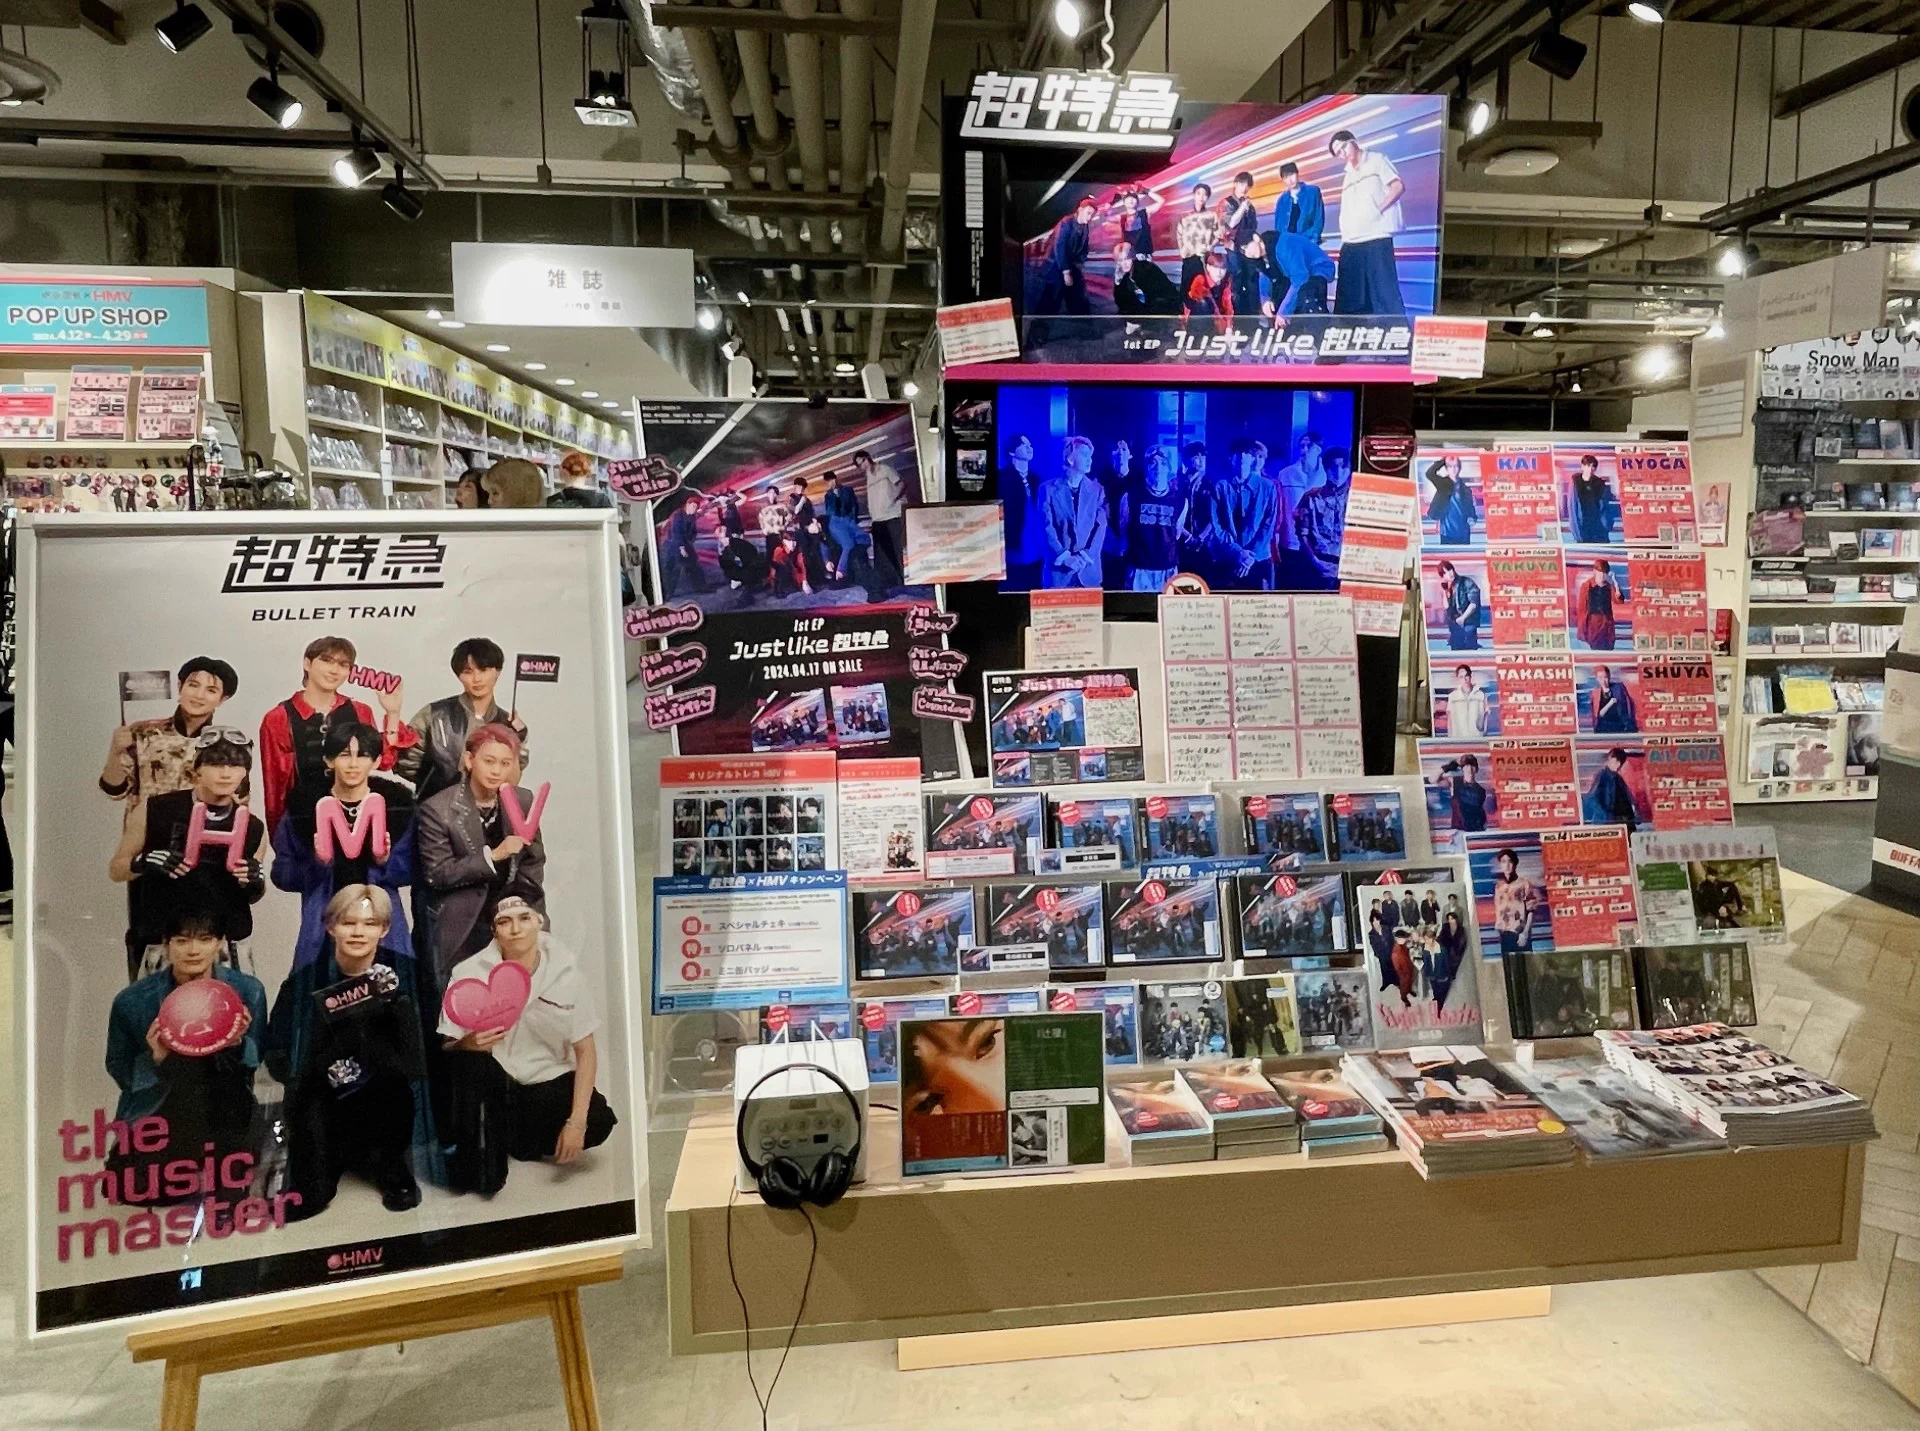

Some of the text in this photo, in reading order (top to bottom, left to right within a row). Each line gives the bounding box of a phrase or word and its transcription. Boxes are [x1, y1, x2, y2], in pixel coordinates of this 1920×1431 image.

[960, 70, 1182, 147] 超特急
[548, 269, 603, 290] 雑誌
[93, 290, 132, 302] HMV
[9, 307, 168, 326] POP UP SHOP
[1124, 339, 1141, 351] 1st
[1143, 339, 1161, 350] EP
[1165, 328, 1248, 357] Just
[1250, 328, 1315, 357] like
[1319, 327, 1412, 357] 超特急
[1809, 350, 1899, 368] Snow Man
[1498, 456, 1538, 471] KAI
[1621, 457, 1687, 470] RYOGA
[222, 534, 448, 593] 超特急
[1639, 563, 1693, 579] YUKI
[252, 604, 417, 622] BULLET TRAIN
[794, 617, 825, 632] 1st EP
[729, 629, 889, 661] Just like 超特急
[530, 661, 556, 672] HMV
[763, 658, 863, 680] 2024.04.17 ON SALE
[1497, 668, 1573, 680] TAKASHI
[1642, 666, 1710, 679] SHUYA
[348, 664, 402, 694] HMV
[687, 769, 760, 780] オリジナルトレカ
[708, 877, 746, 890] 超特急
[757, 874, 788, 888] HMV
[790, 873, 842, 885] キャンペーン
[719, 919, 785, 931] スペシャルチェキ
[718, 943, 761, 953] ソロパネル
[337, 983, 369, 1006] HMV
[57, 1108, 169, 1162] the
[57, 1143, 254, 1212] music
[57, 1190, 303, 1263] master
[342, 1246, 384, 1267] HMV
